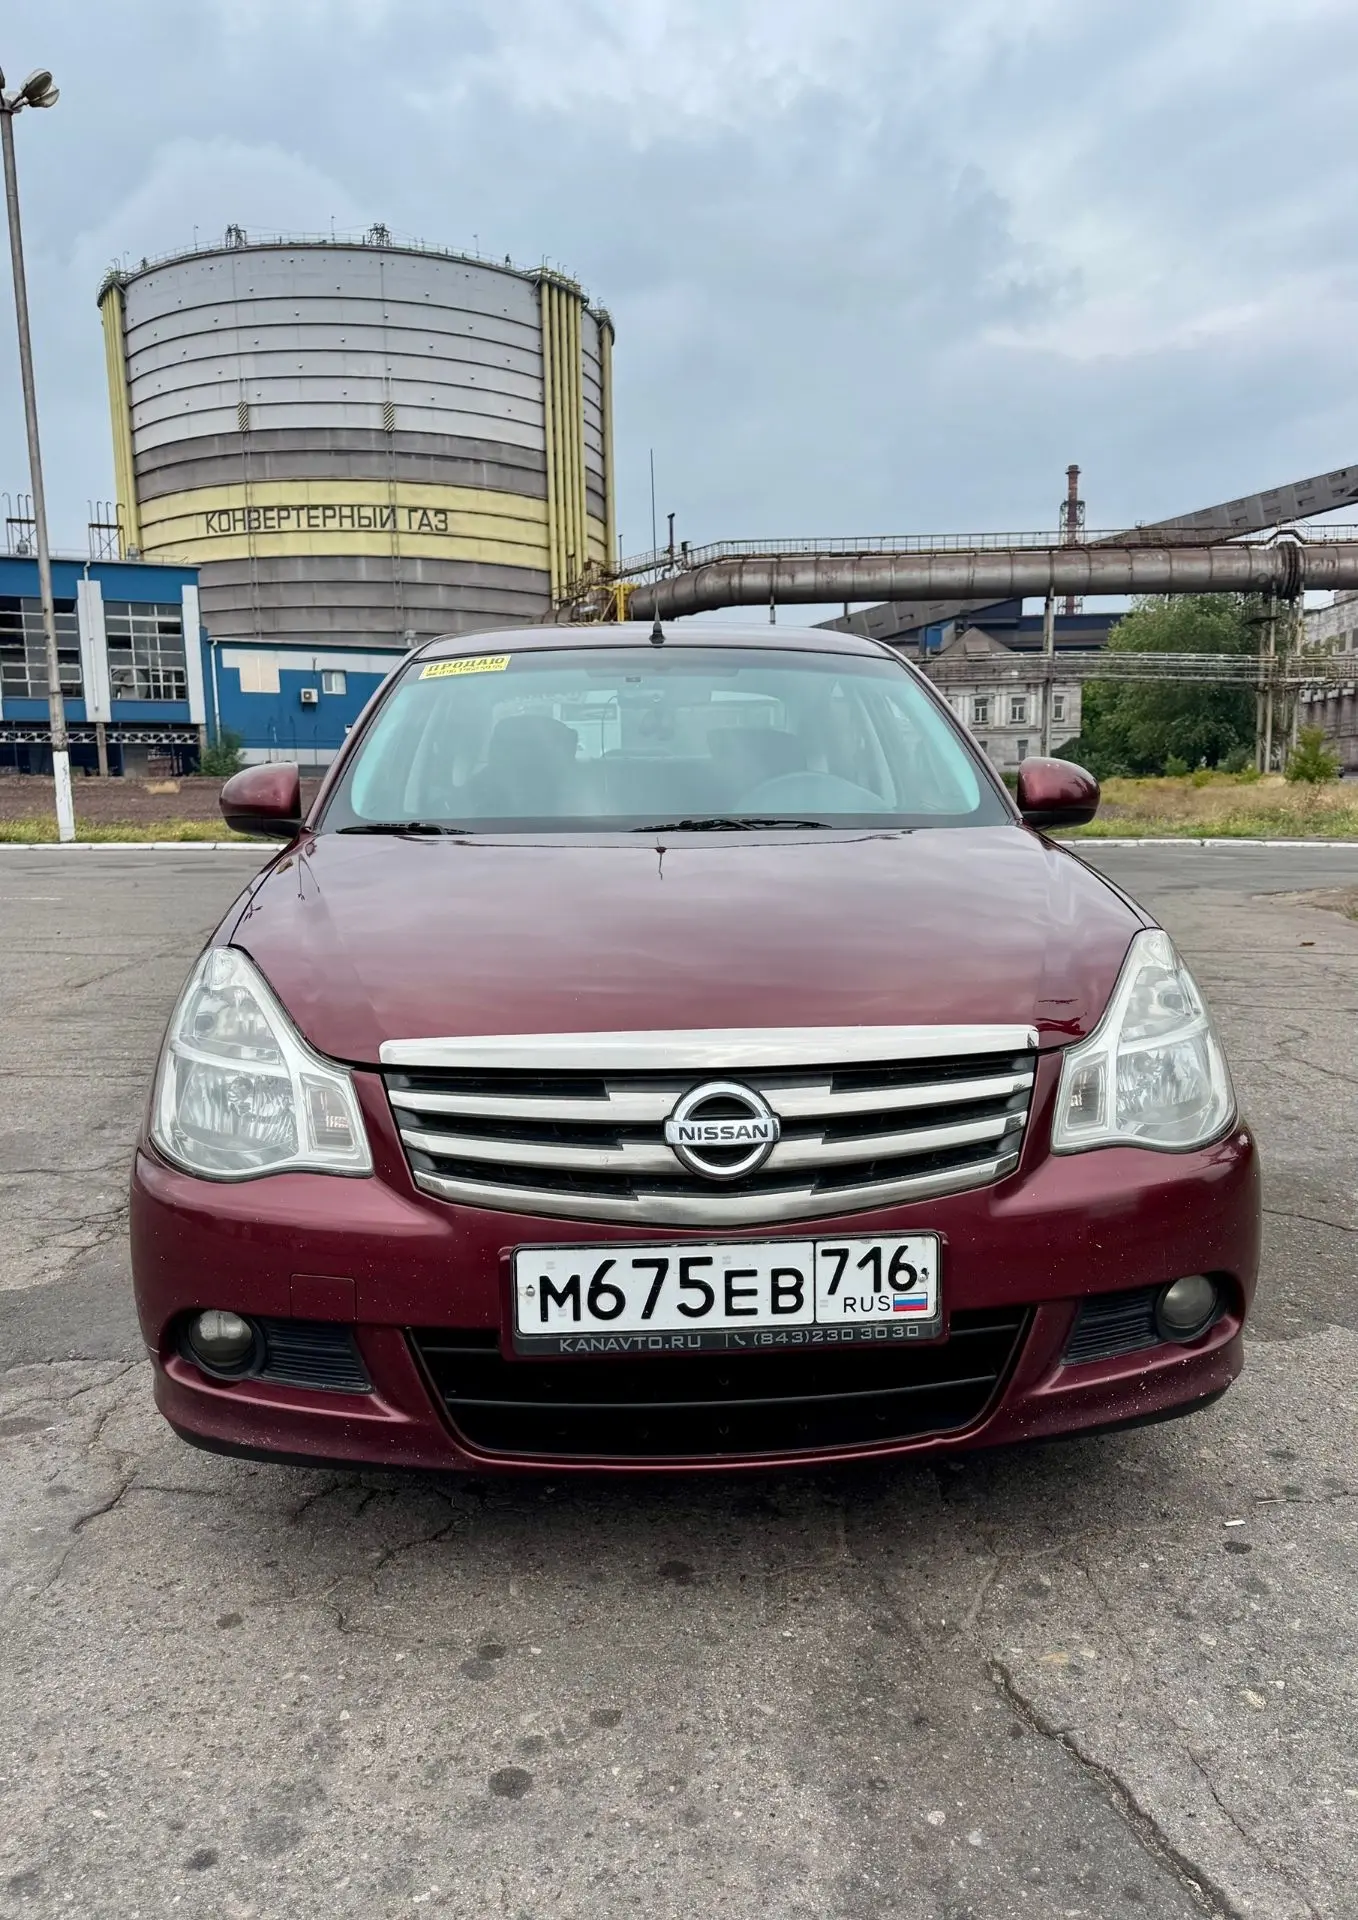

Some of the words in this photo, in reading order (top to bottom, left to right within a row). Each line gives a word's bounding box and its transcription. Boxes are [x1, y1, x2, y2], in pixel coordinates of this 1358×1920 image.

[206, 505, 397, 534] КОНВЕРТЕРНЫЙ
[407, 509, 449, 532] ГАЗ
[428, 657, 505, 672] ПРОДАЮ
[678, 1124, 768, 1141] NISSAN
[821, 1245, 918, 1296] 716
[844, 1295, 891, 1313] RUS
[860, 1327, 888, 1341] 30
[892, 1325, 920, 1339] 30
[559, 1334, 702, 1352] KANAVTO.RU
